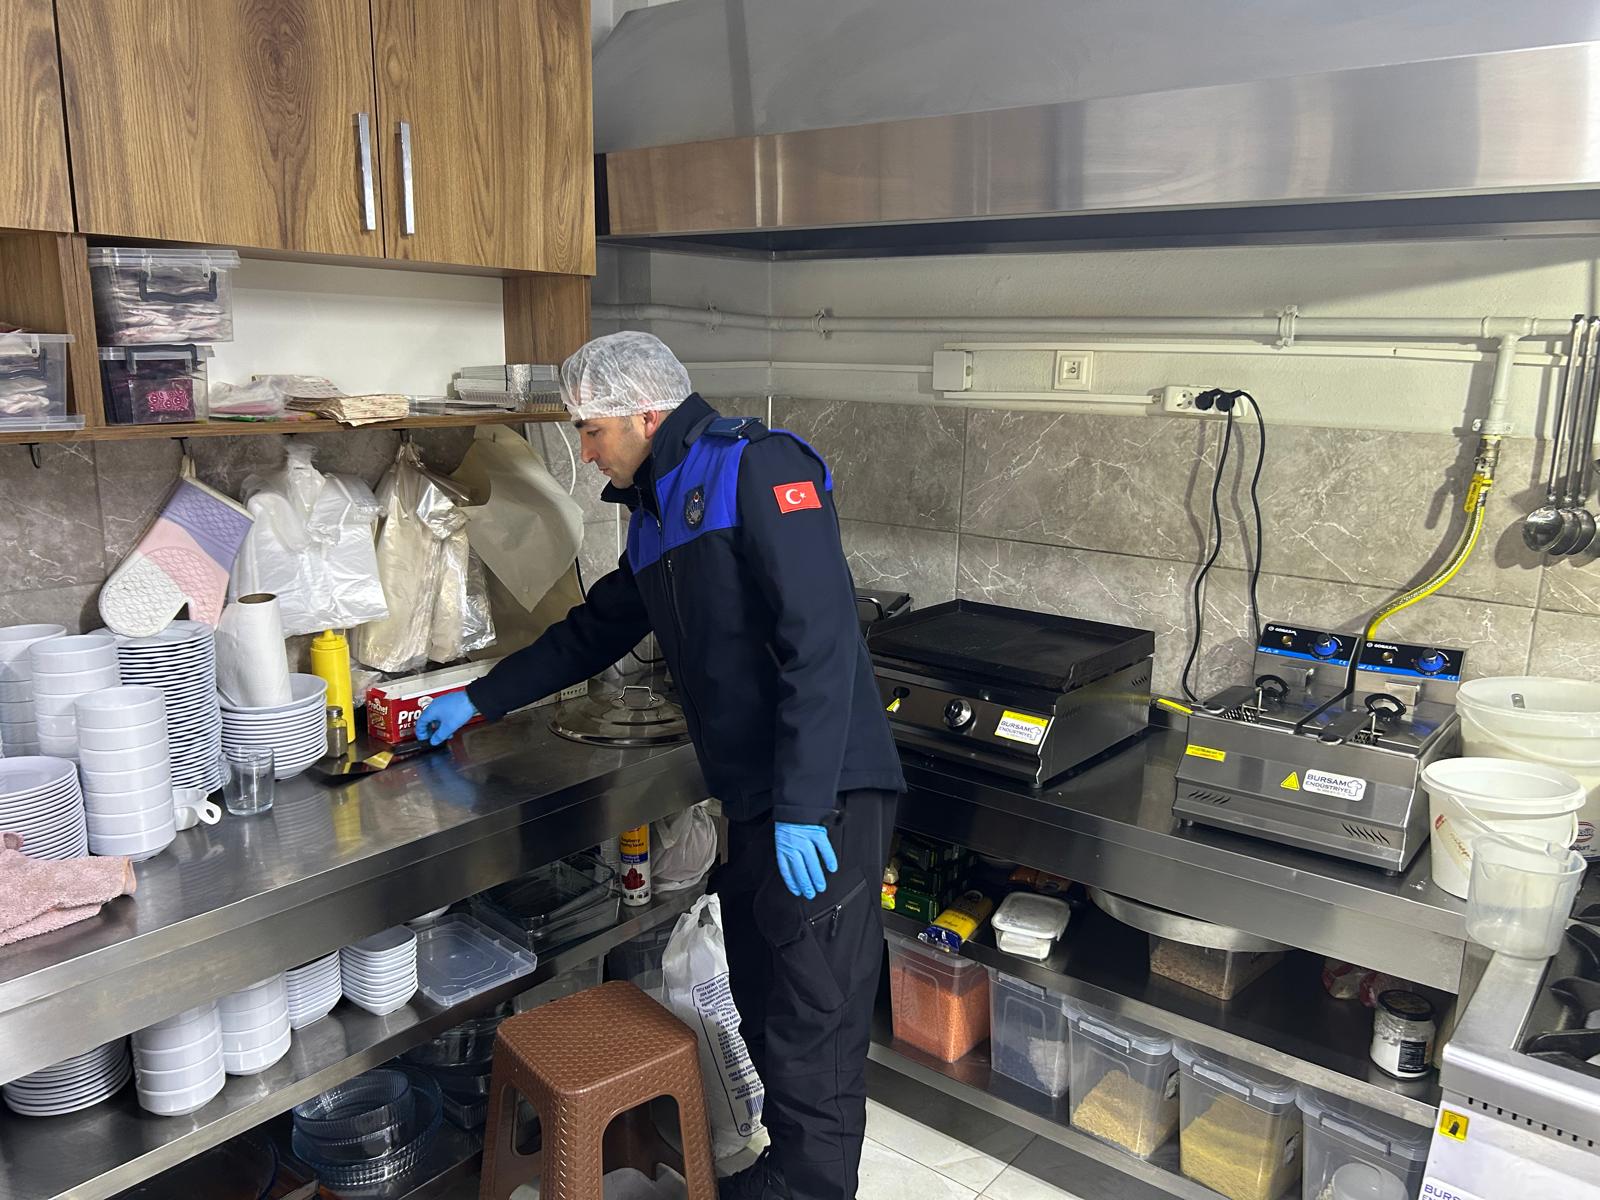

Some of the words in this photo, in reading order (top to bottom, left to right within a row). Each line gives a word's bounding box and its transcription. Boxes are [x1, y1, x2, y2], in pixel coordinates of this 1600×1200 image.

[398, 710, 422, 725] Pro
[1000, 720, 1031, 731] BURSAM
[1306, 773, 1347, 787] BURSAM
